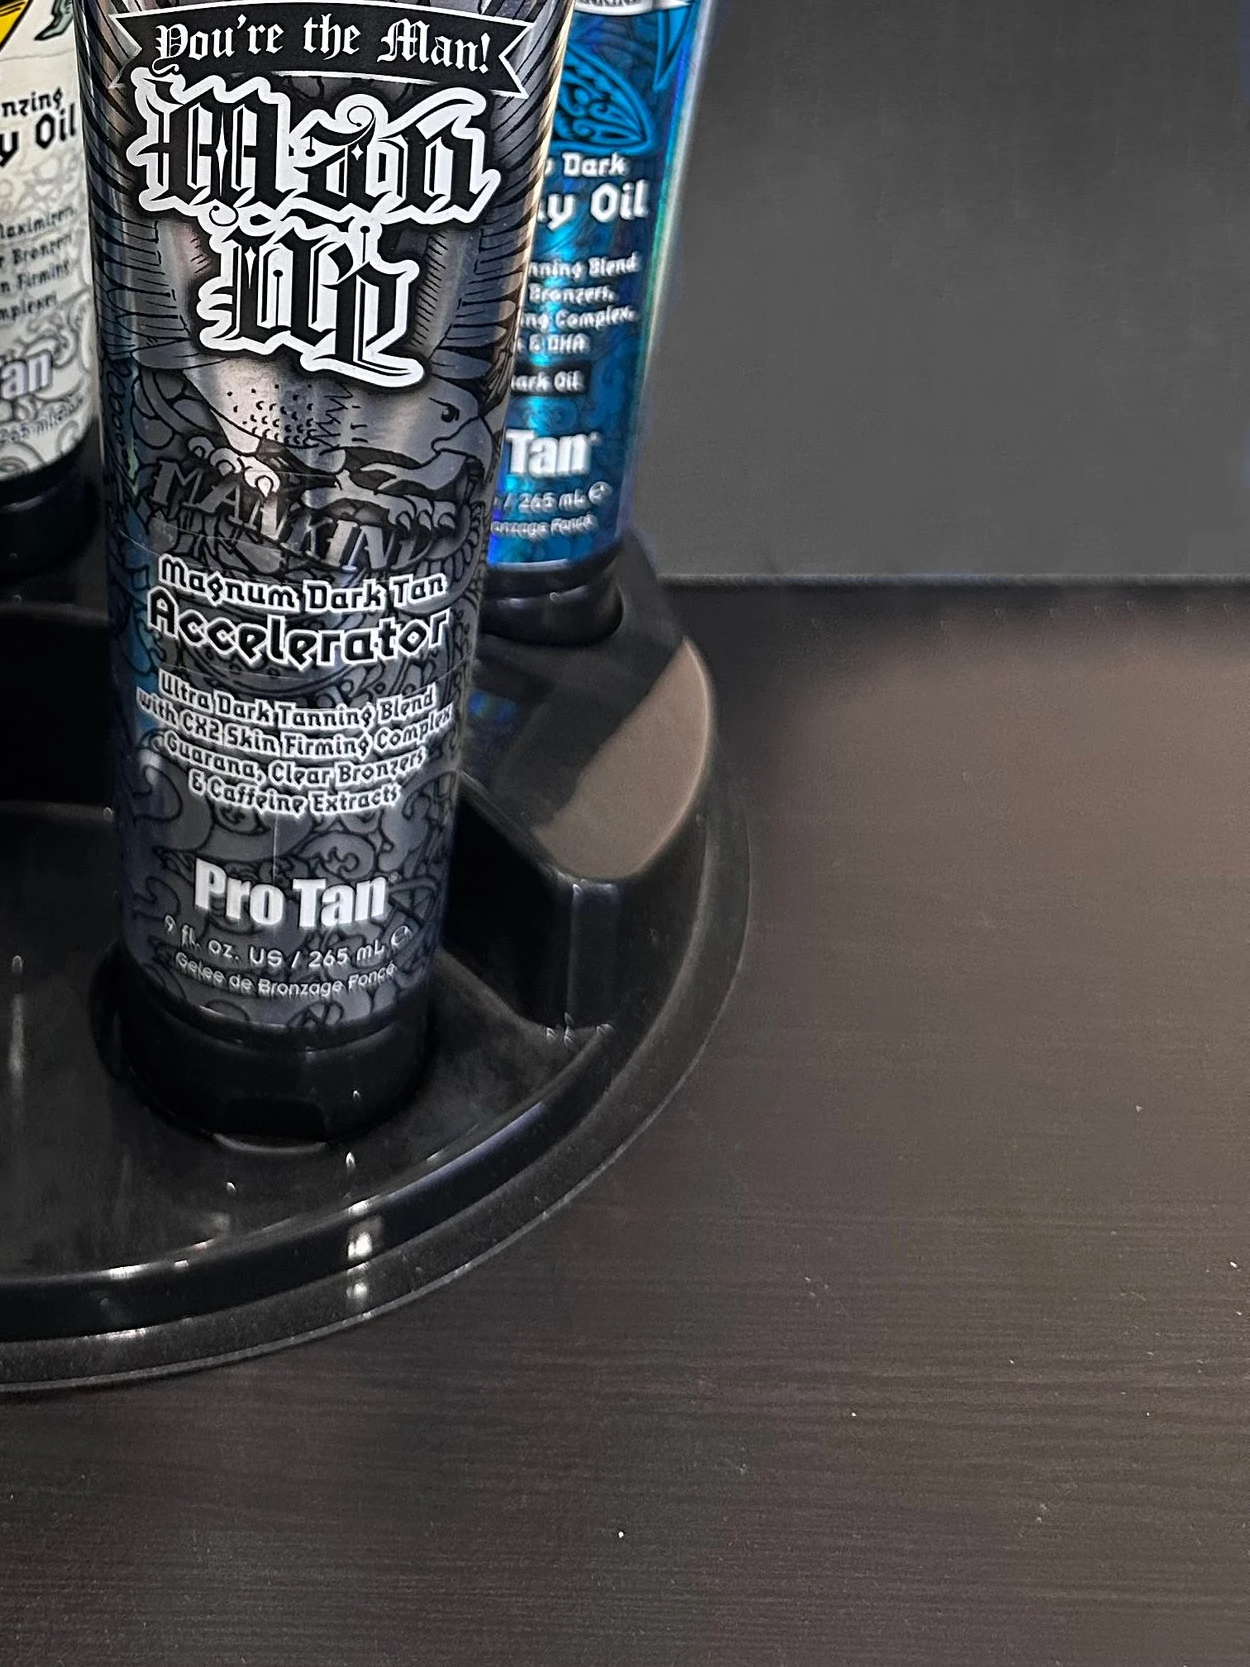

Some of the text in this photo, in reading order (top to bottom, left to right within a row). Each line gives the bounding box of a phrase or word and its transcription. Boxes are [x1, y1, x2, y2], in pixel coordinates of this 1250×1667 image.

[152, 13, 491, 74] You're the Man!
[35, 102, 77, 149] Oil
[562, 151, 629, 177] Dark
[590, 179, 648, 222] Oil
[589, 251, 641, 277] Blend
[506, 428, 589, 478] Tan
[159, 554, 448, 612] Magnum Dark Tan
[148, 586, 450, 670] Accelerator
[138, 688, 452, 758] with CX2 Skin Firming Complex
[160, 669, 434, 729] Ultra Dark Tanning Blend
[166, 733, 423, 787] Guarana, Clear Bronzers
[190, 770, 399, 815] & Caffeine Extracts
[195, 858, 387, 927] Pro Tan
[163, 914, 177, 932] 9
[208, 939, 240, 961] oz.
[249, 946, 282, 967] US
[308, 948, 348, 968] 265
[357, 939, 386, 961] mL
[229, 973, 254, 992] de
[258, 978, 344, 998] Bronzage
